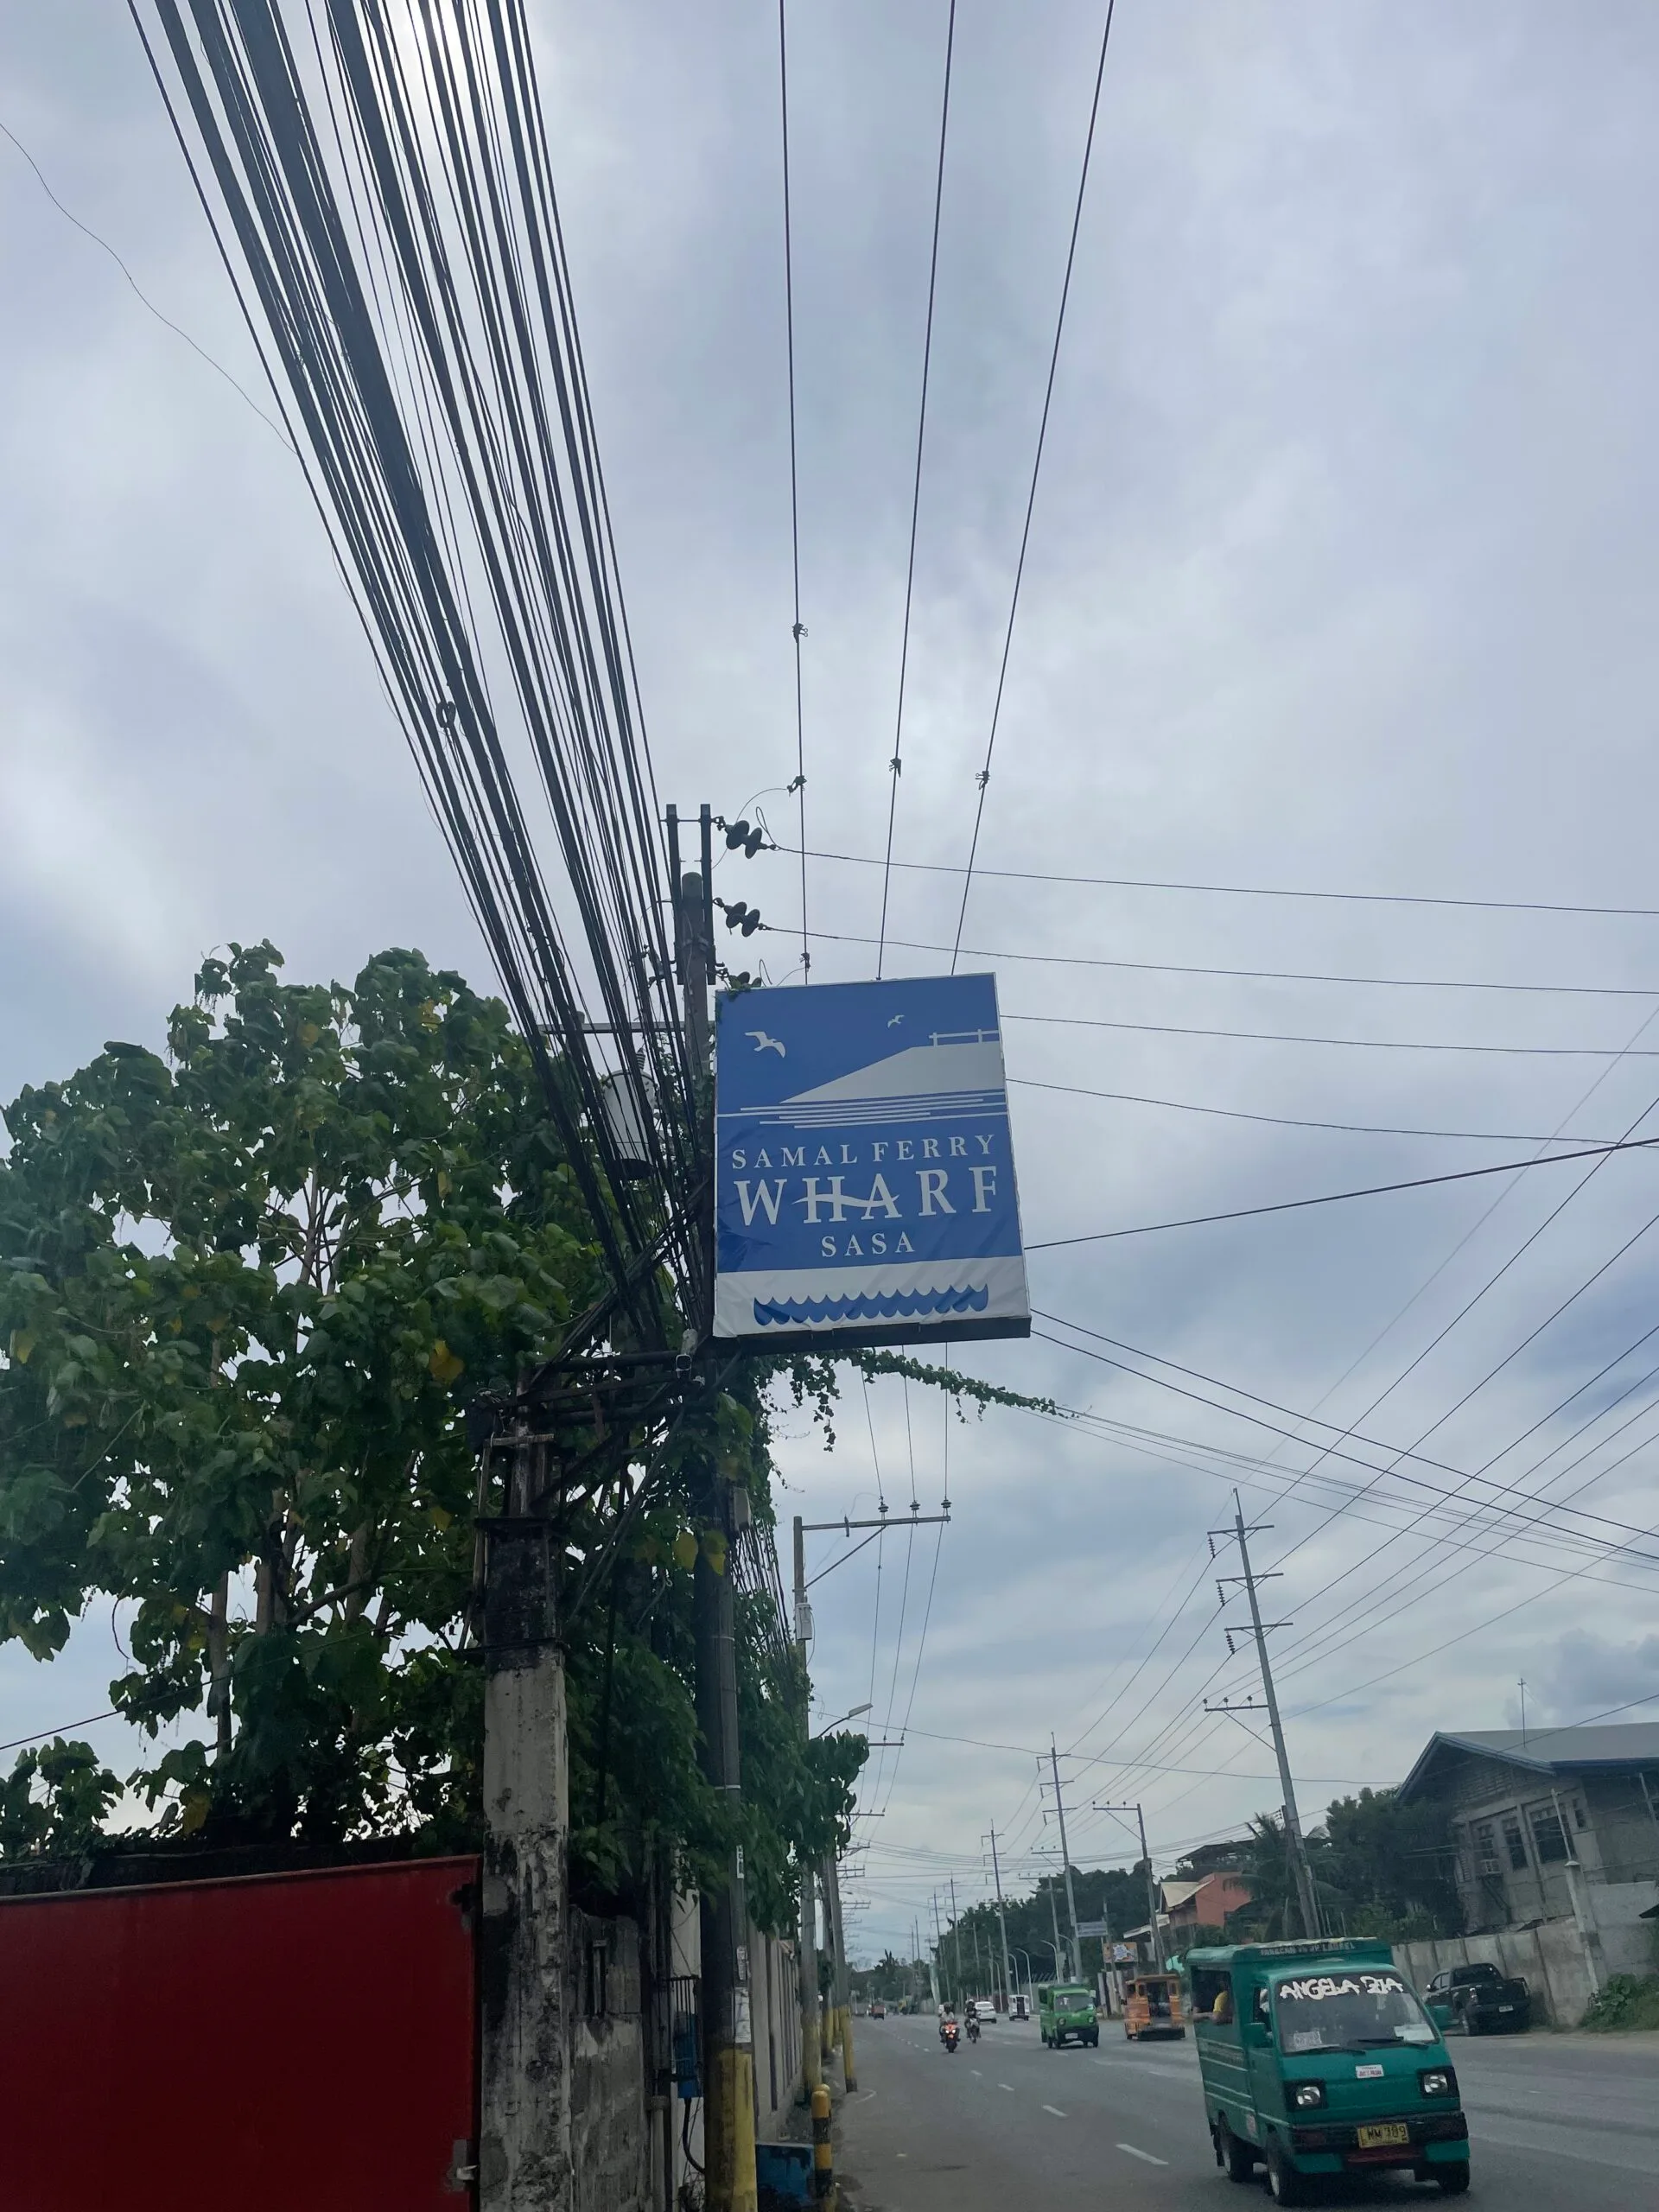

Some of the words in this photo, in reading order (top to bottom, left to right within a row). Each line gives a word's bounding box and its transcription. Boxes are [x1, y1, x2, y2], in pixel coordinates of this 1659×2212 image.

[732, 1144, 858, 1169] SAMAL
[872, 1134, 995, 1162] FERRY
[733, 1165, 997, 1226] WHARF
[821, 1231, 915, 1258] SASA
[1280, 1977, 1360, 2000] ANGELA
